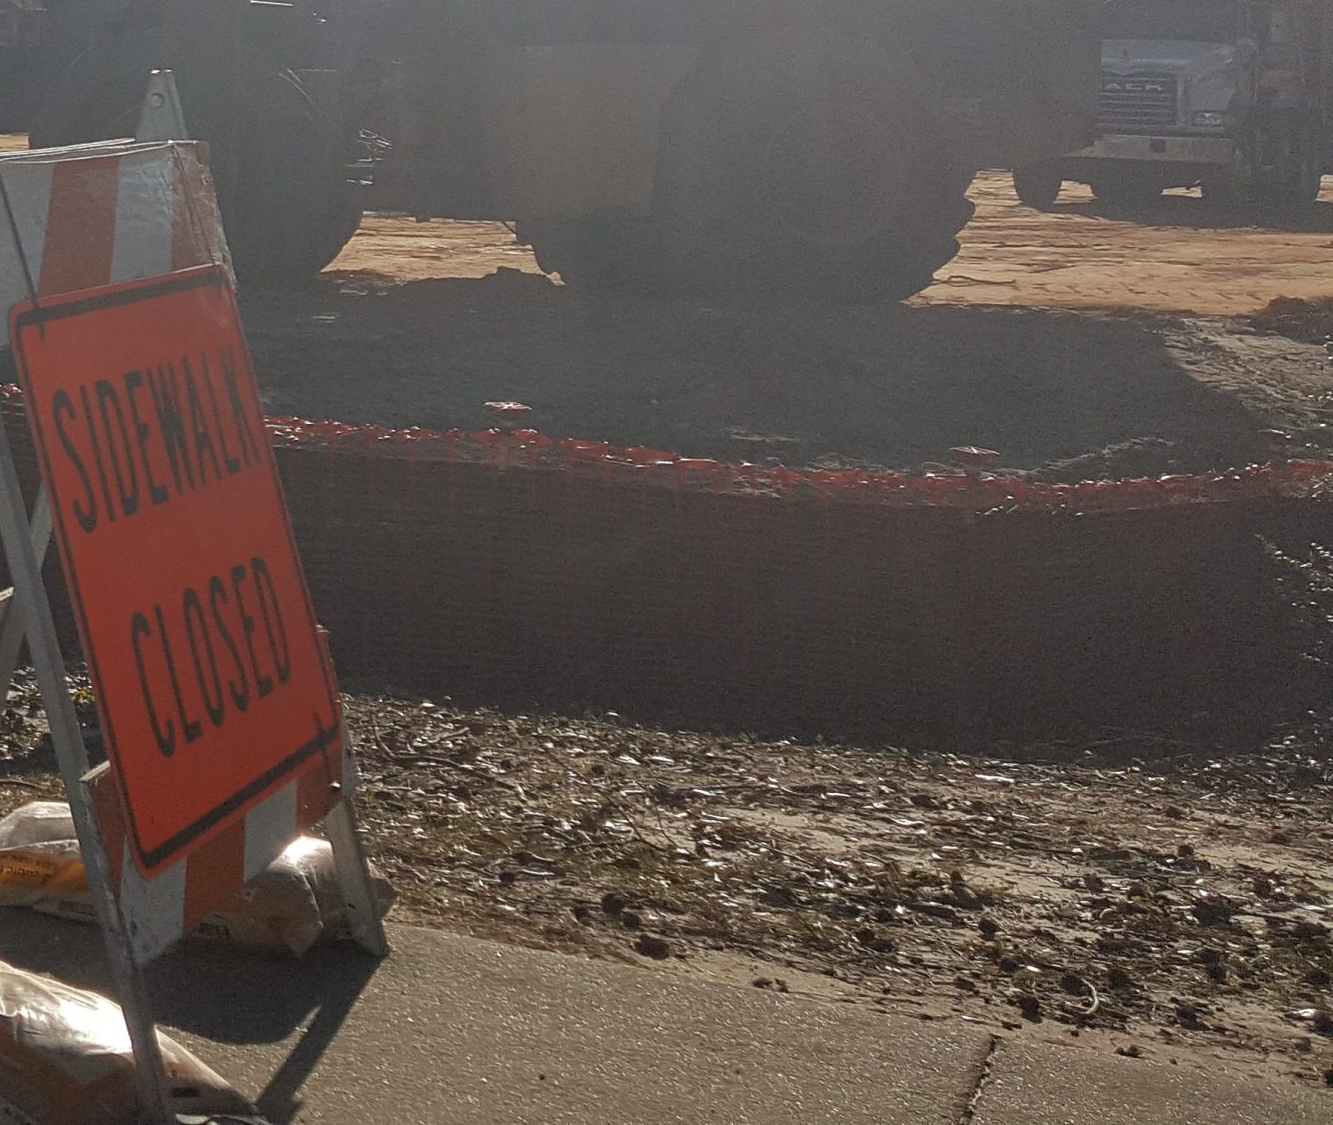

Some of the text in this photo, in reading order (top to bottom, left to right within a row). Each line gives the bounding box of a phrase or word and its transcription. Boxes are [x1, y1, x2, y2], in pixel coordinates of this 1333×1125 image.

[1105, 82, 1165, 92] ACK
[52, 343, 262, 534] SIDEWALK
[131, 555, 291, 758] CLOSED
